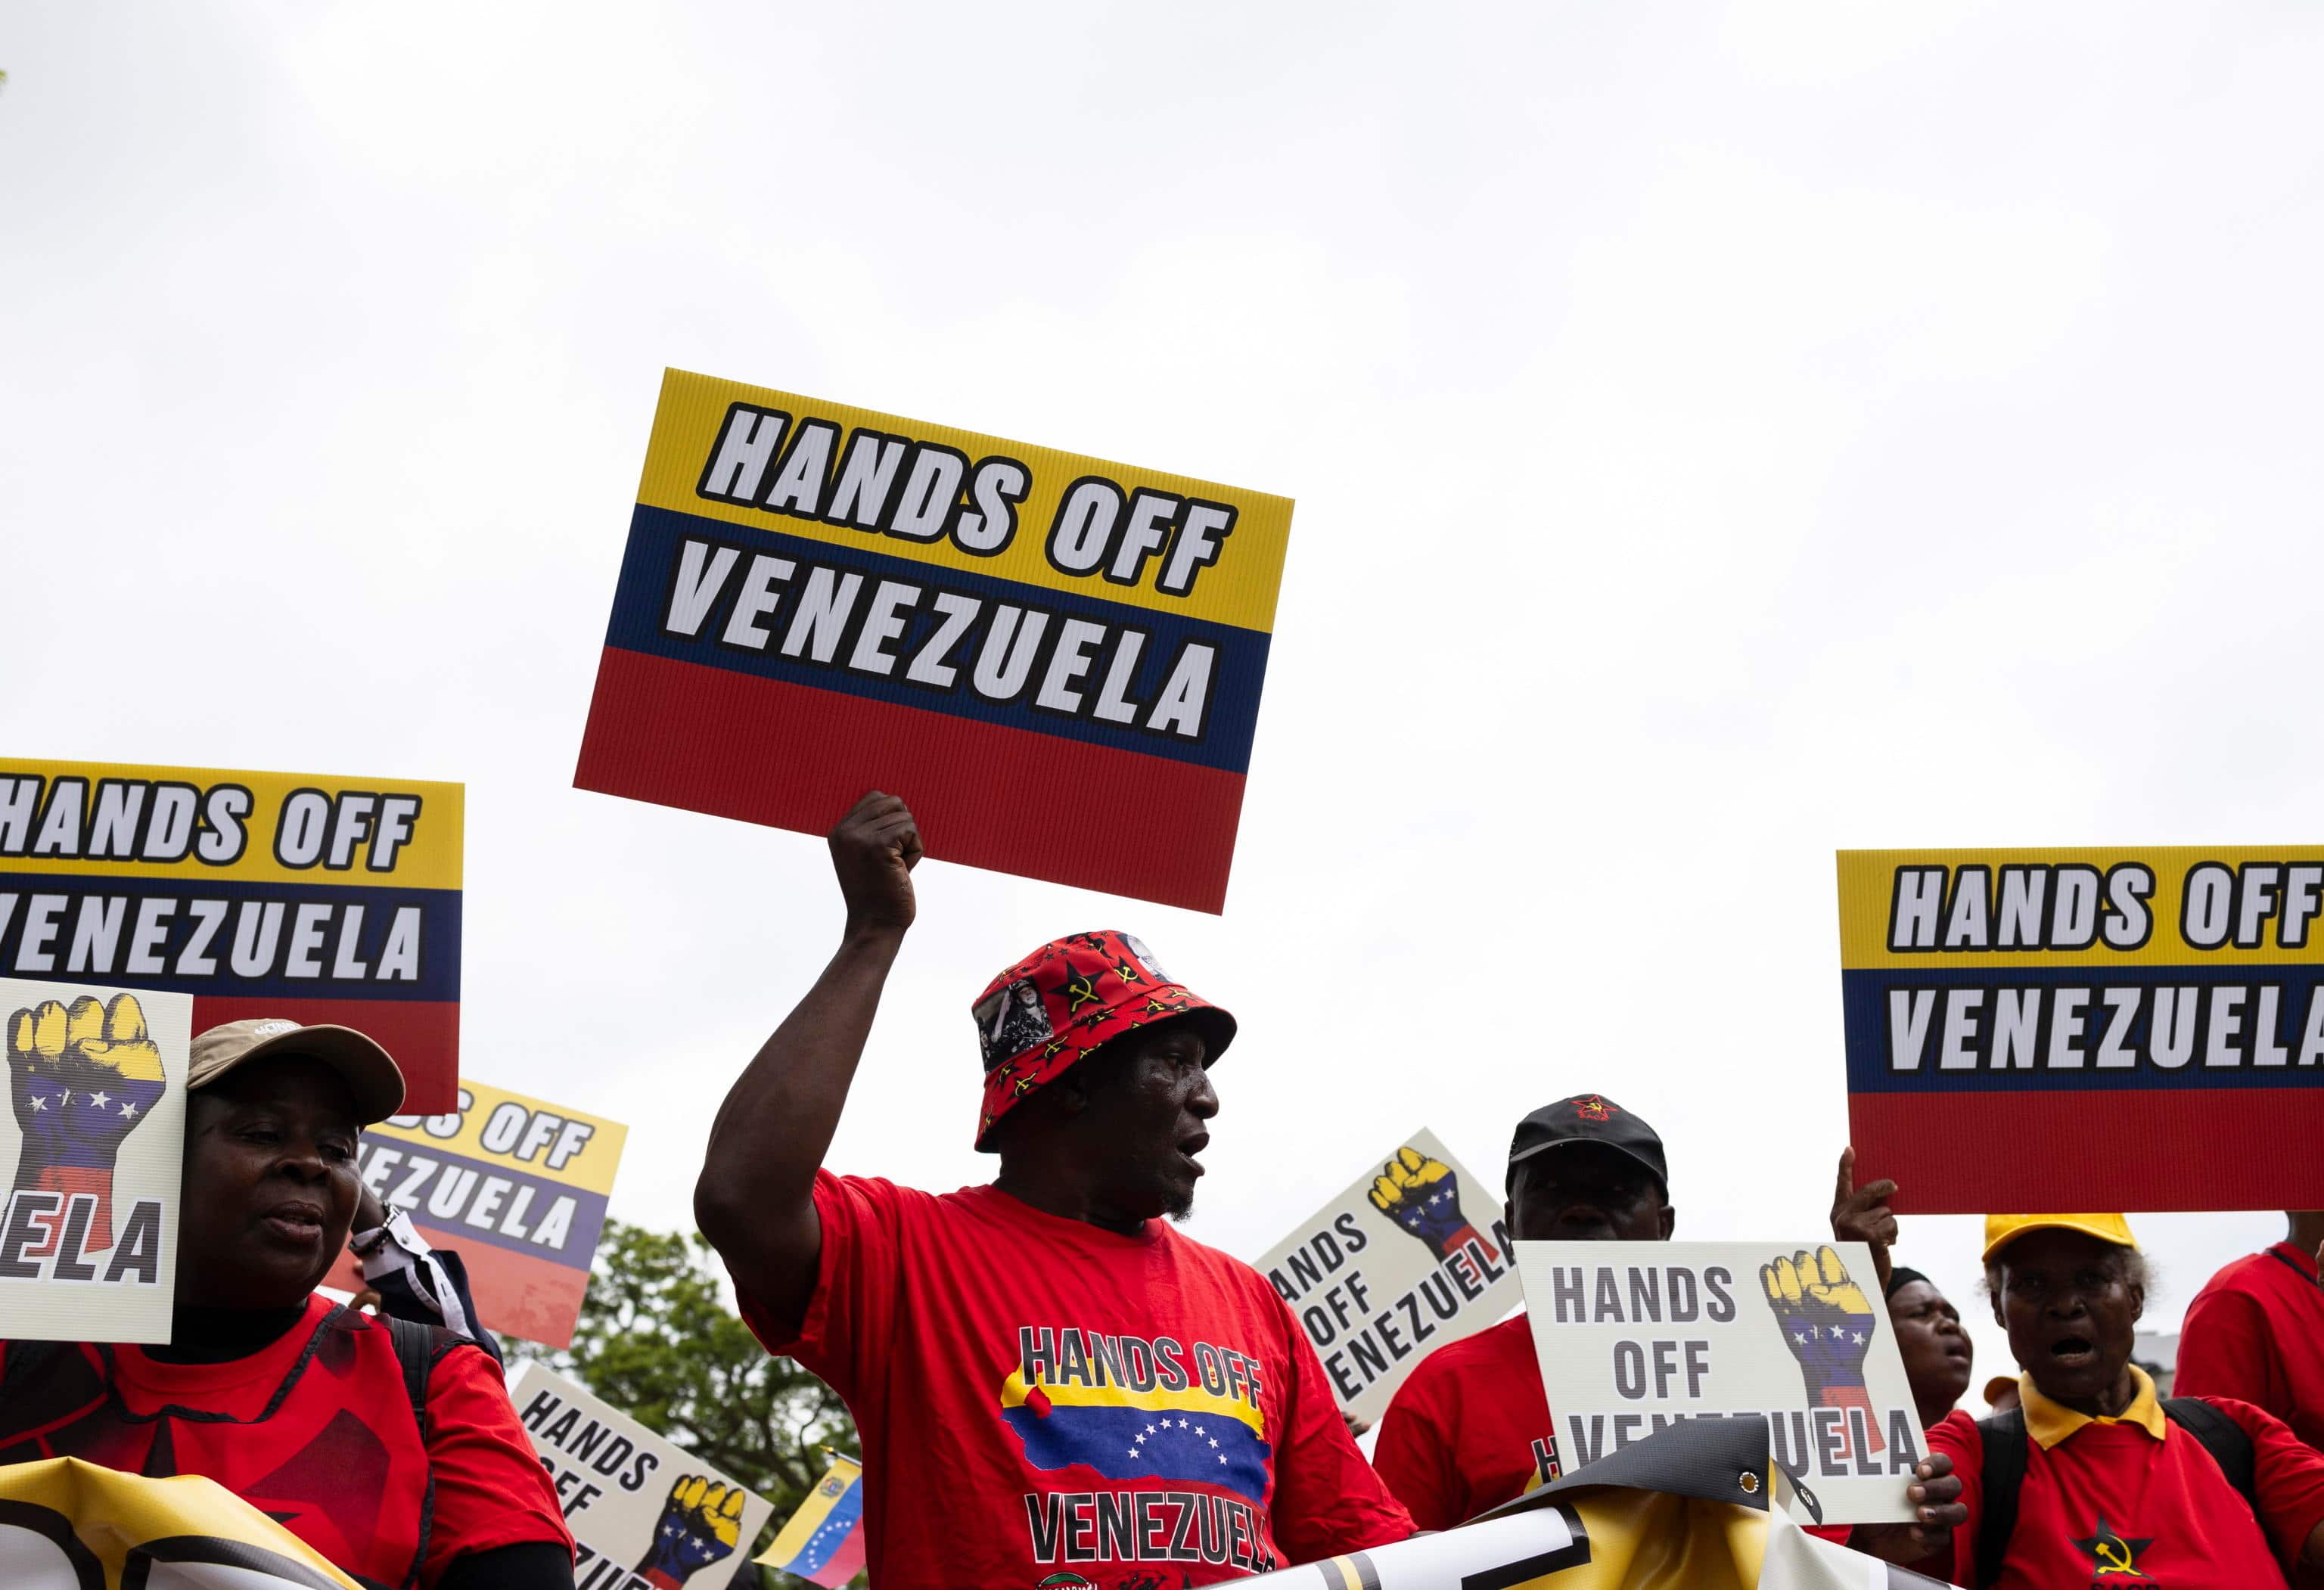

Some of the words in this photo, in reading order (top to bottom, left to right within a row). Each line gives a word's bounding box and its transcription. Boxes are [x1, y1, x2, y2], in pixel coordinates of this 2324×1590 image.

[698, 402, 1030, 557] HANDS
[1046, 477, 1238, 596] OFF
[663, 537, 1217, 741] VENEZUELA
[274, 789, 421, 871] OFF
[1888, 862, 2155, 951] HANDS
[2180, 861, 2324, 950] OFF
[480, 1101, 595, 1170] OFF
[359, 1142, 577, 1250] EZUELA
[1303, 1271, 1371, 1346] OFF
[1552, 1266, 1736, 1323] HANDS
[1019, 1326, 1189, 1393] HANDS
[1193, 1342, 1262, 1410] OFF
[1614, 1340, 1709, 1399] OFF
[520, 1390, 659, 1492] HANDS
[539, 1456, 602, 1519] FF
